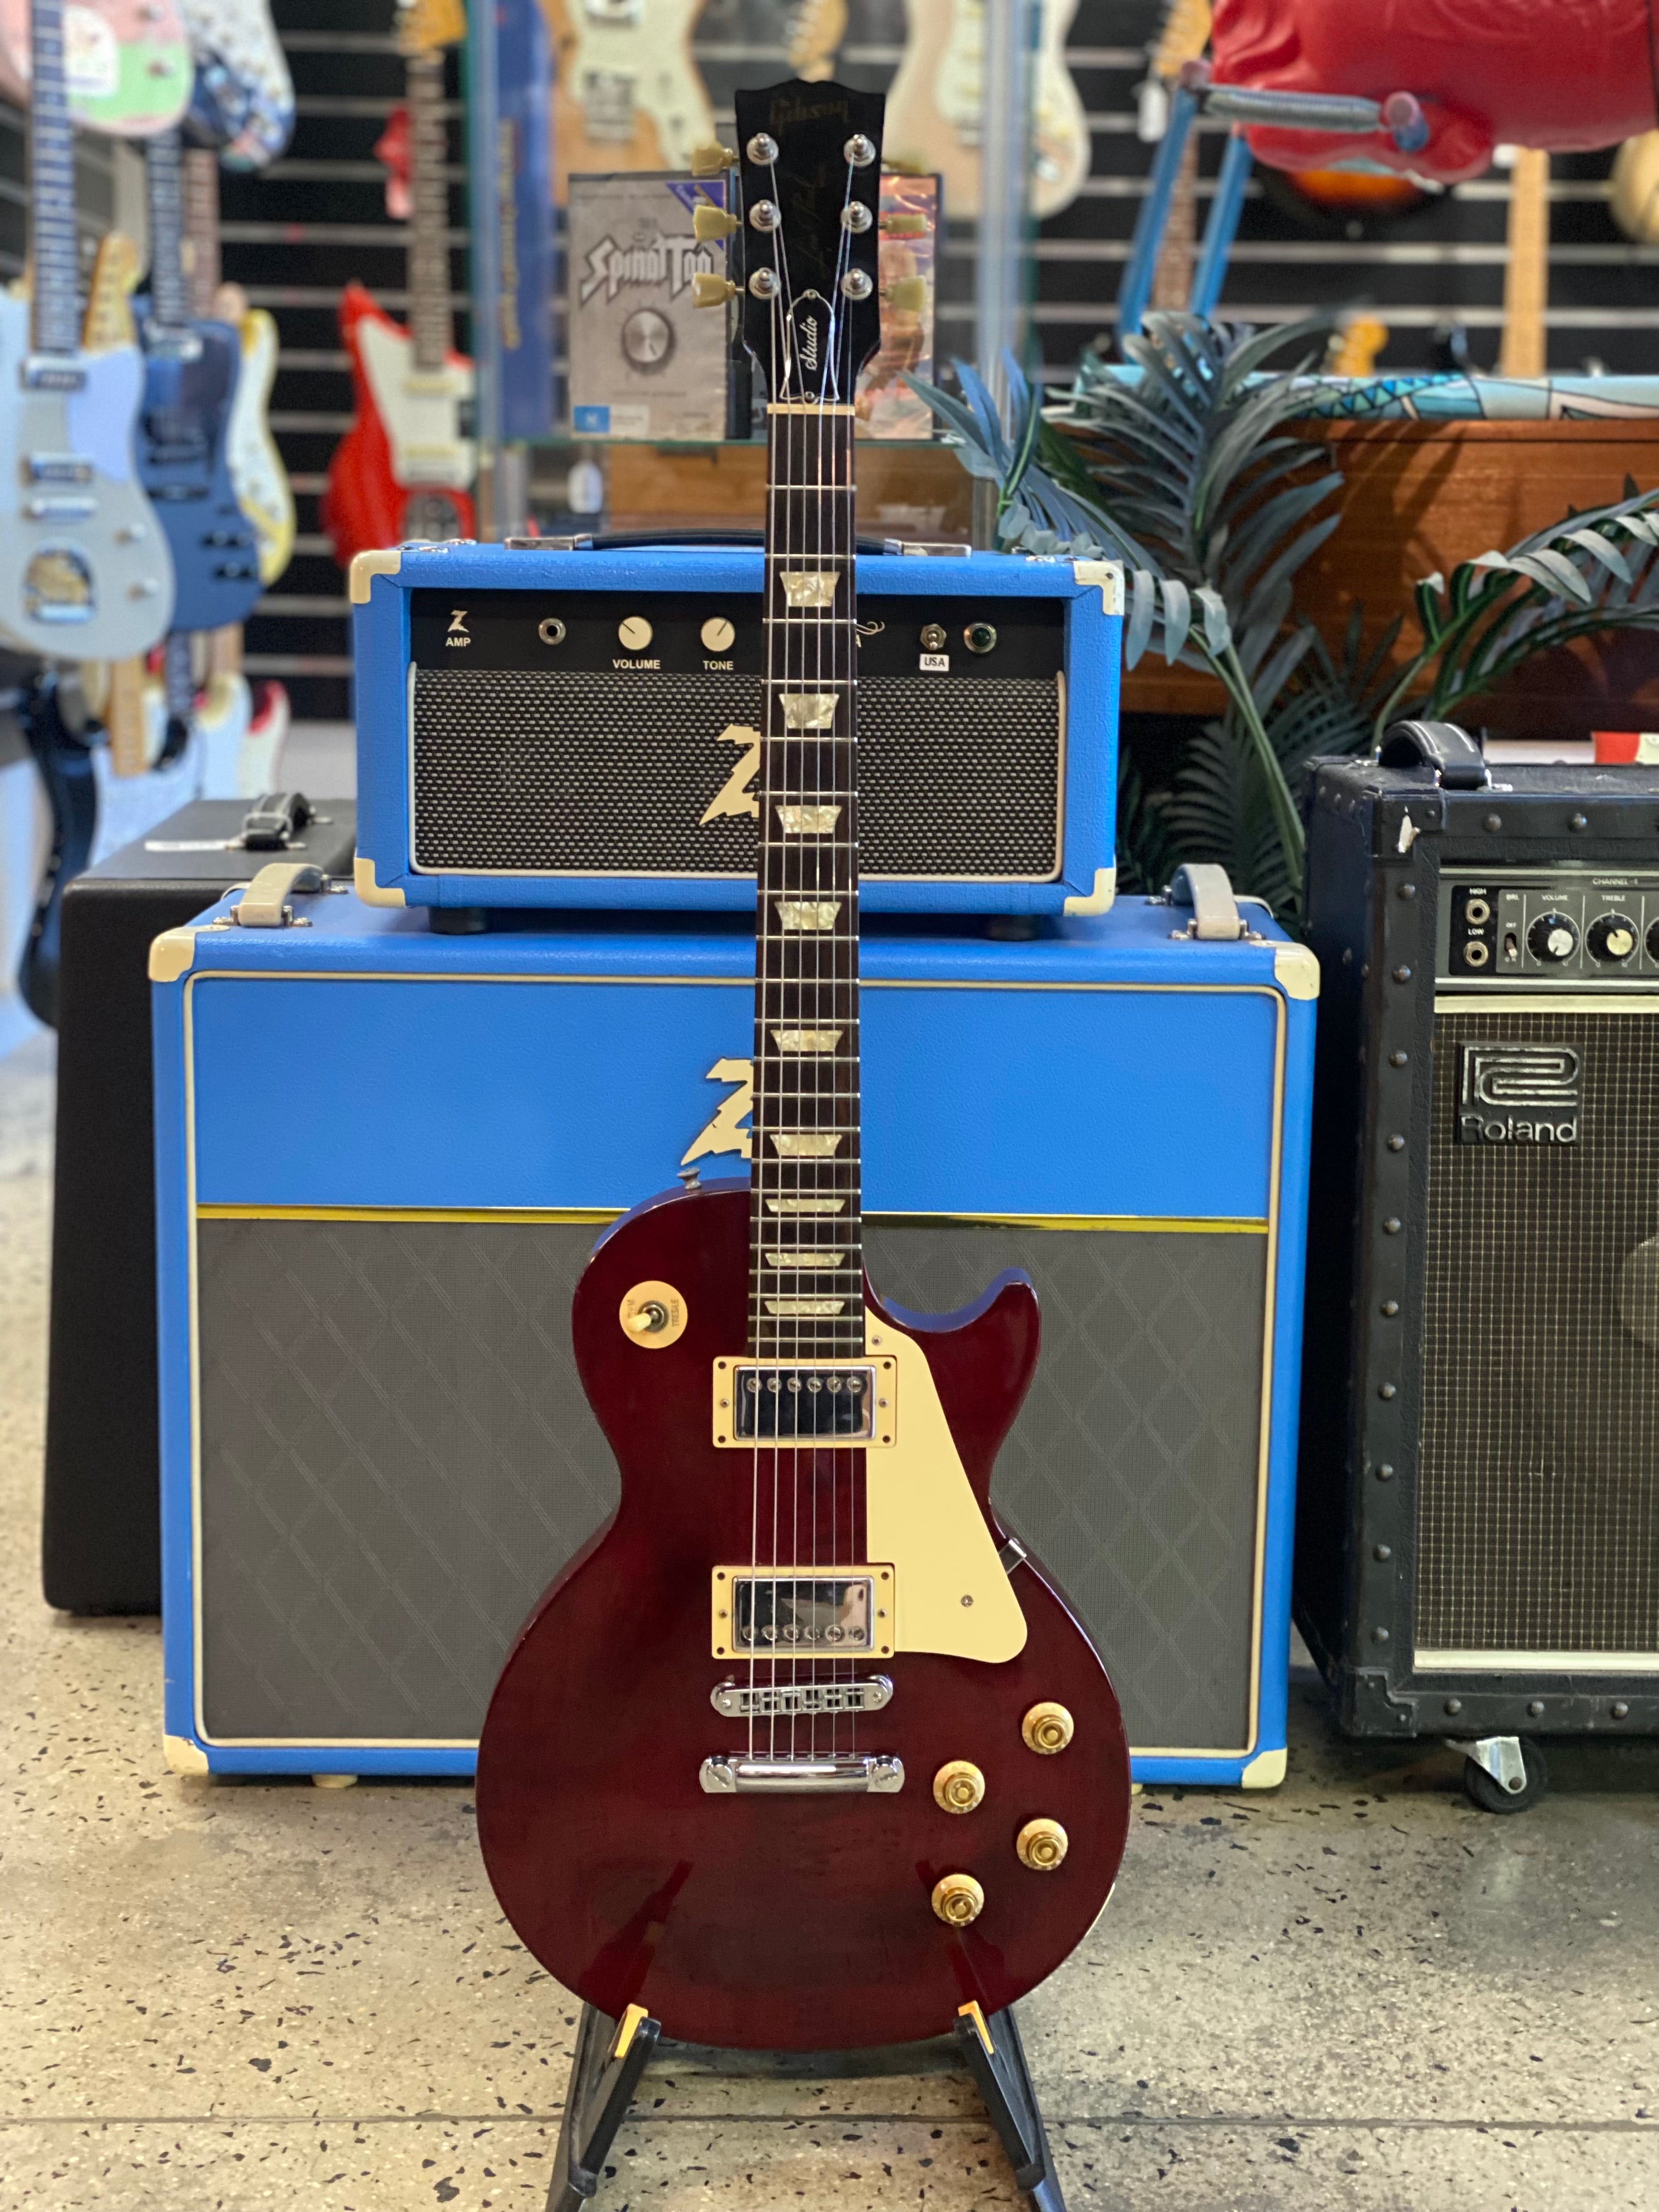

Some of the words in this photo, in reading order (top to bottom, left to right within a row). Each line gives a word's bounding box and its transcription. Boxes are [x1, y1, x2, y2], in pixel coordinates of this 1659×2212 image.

[799, 315, 817, 371] Studio
[445, 637, 471, 647] AMP
[612, 659, 661, 669] VOLUME
[703, 660, 734, 670] TONE
[924, 657, 946, 667] USA
[1462, 1115, 1578, 1143] Roland
